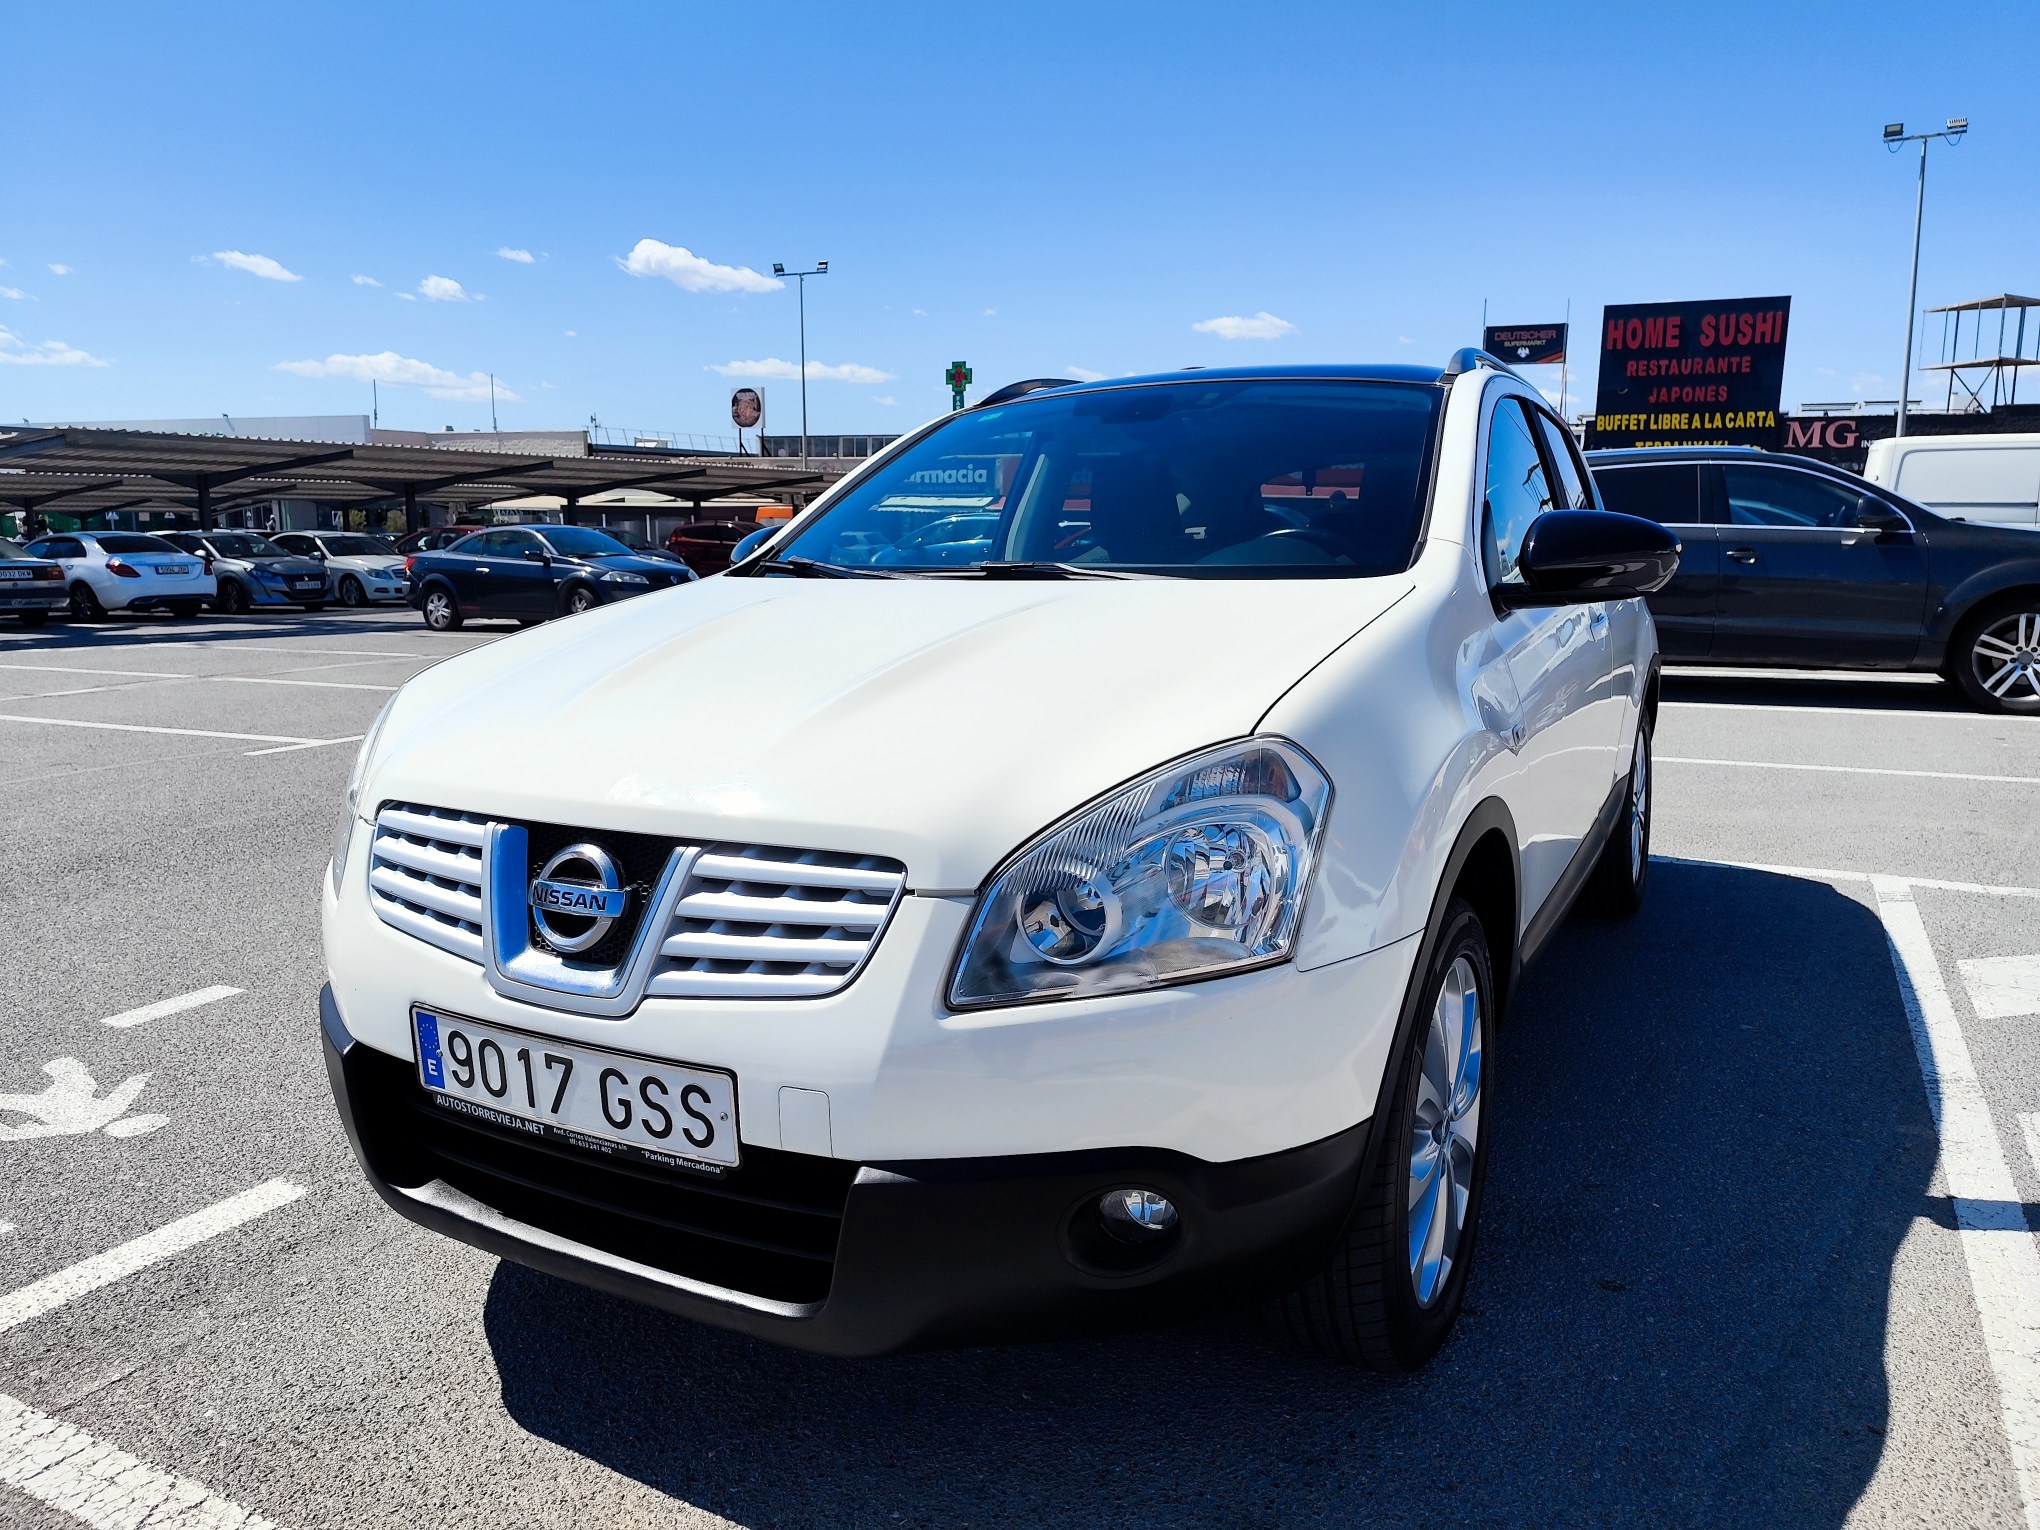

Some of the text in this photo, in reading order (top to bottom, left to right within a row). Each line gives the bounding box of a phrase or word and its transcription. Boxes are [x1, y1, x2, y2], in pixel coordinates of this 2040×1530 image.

[1494, 329, 1556, 341] DEUTSCHER
[1606, 311, 1783, 350] HOME SUSHI
[1626, 356, 1751, 377] RESTAURANTE
[1648, 385, 1728, 404] JAPONES
[1596, 411, 1776, 431] BUFFET LIBRE A LA CARTA
[1783, 420, 1860, 449] MG
[532, 886, 608, 911] NISSAN
[427, 1058, 439, 1076] E
[447, 1030, 715, 1149] 9017 GSS
[436, 1094, 545, 1135] AUTOSTORREVIEJA.NET
[566, 1131, 584, 1141] Cortes
[584, 1135, 618, 1149] Valencianas
[578, 1141, 589, 1149] 633
[589, 1143, 600, 1151] 241
[600, 1146, 612, 1154] 402
[641, 1150, 724, 1174] "Parking Mercadona"
